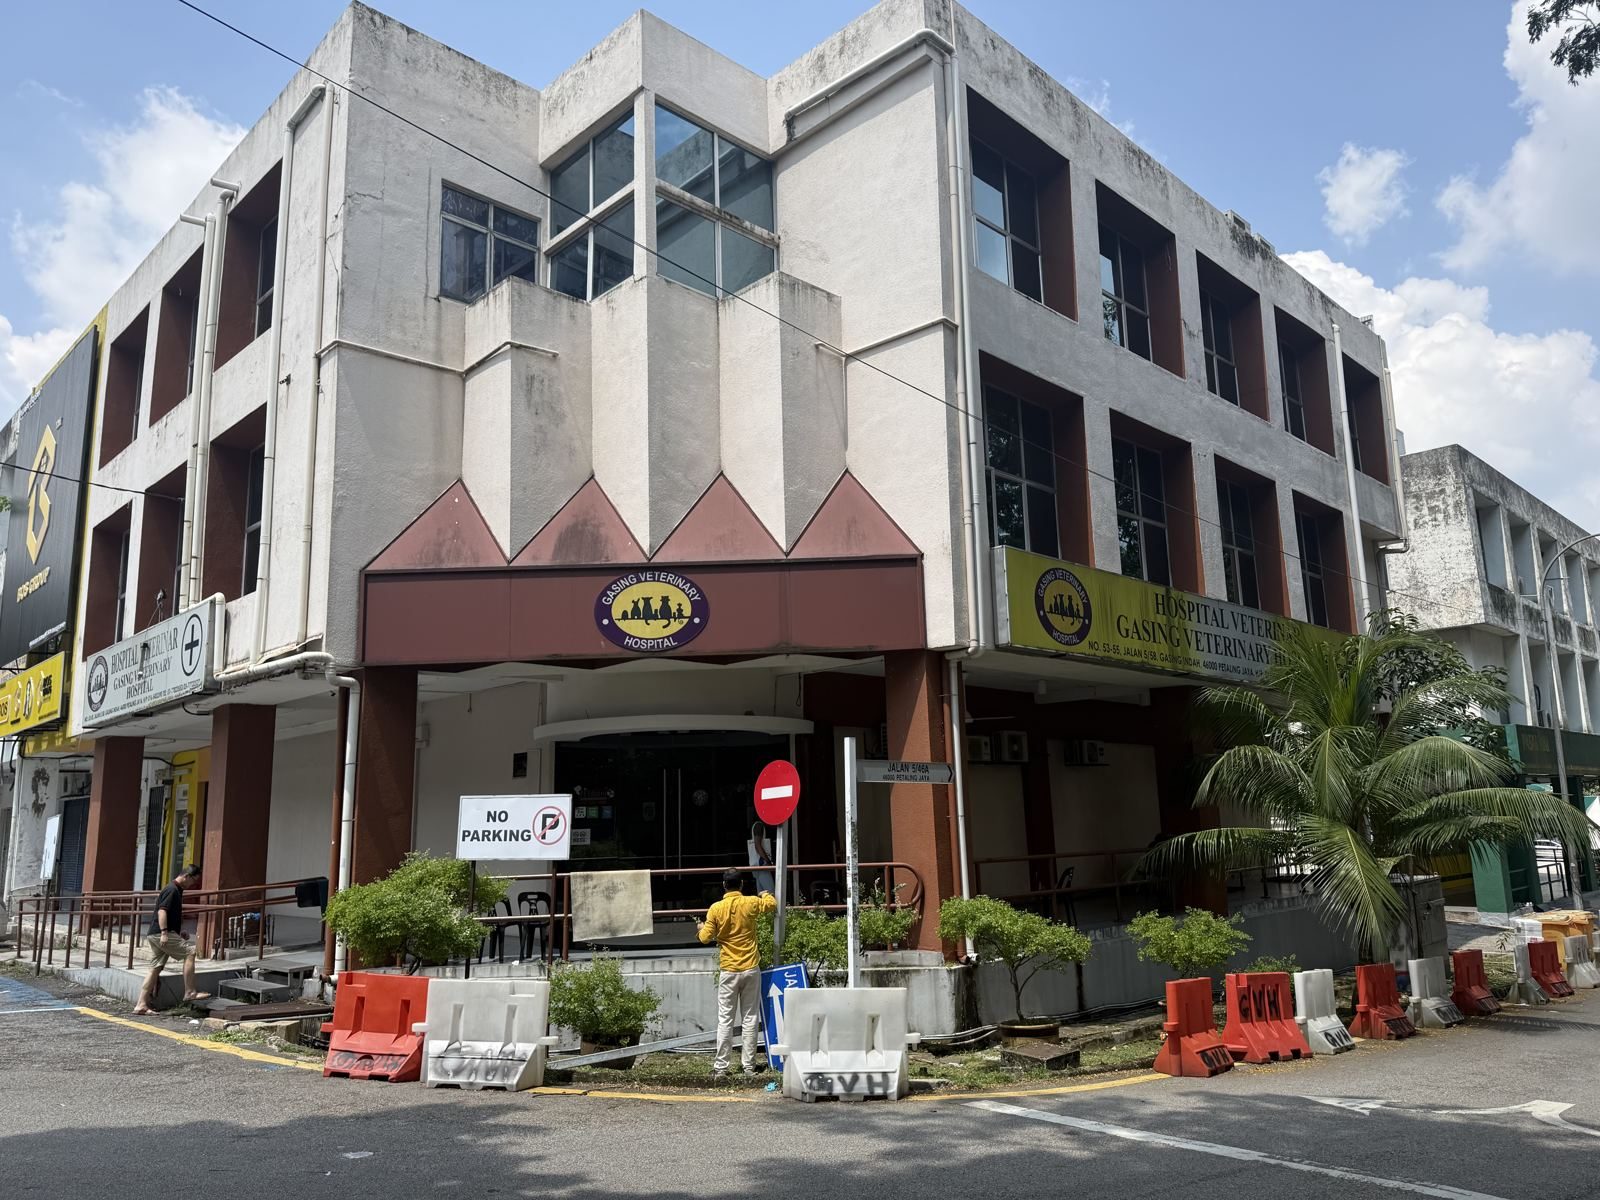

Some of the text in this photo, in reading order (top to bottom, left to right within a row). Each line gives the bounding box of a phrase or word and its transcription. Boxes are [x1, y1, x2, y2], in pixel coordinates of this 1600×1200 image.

[602, 571, 701, 605] GASING VETERINARY
[1038, 570, 1088, 603] GASING VETERINARY
[1155, 592, 1229, 630] HOSPITAL
[623, 636, 678, 649] HOSPITAL
[1052, 629, 1080, 645] HOSPITAL
[1116, 614, 1180, 648] GASING
[1183, 628, 1272, 665] VETERINARY
[111, 643, 139, 675] HOSPITAL
[1088, 640, 1100, 652] NO.
[1123, 647, 1143, 659] JALAN
[113, 671, 135, 691] GASING
[134, 656, 173, 682] VTERINARY
[126, 679, 154, 699] HOSPITAL
[888, 762, 910, 773] JALAN
[486, 810, 509, 823] NO
[461, 829, 532, 842] PARKING
